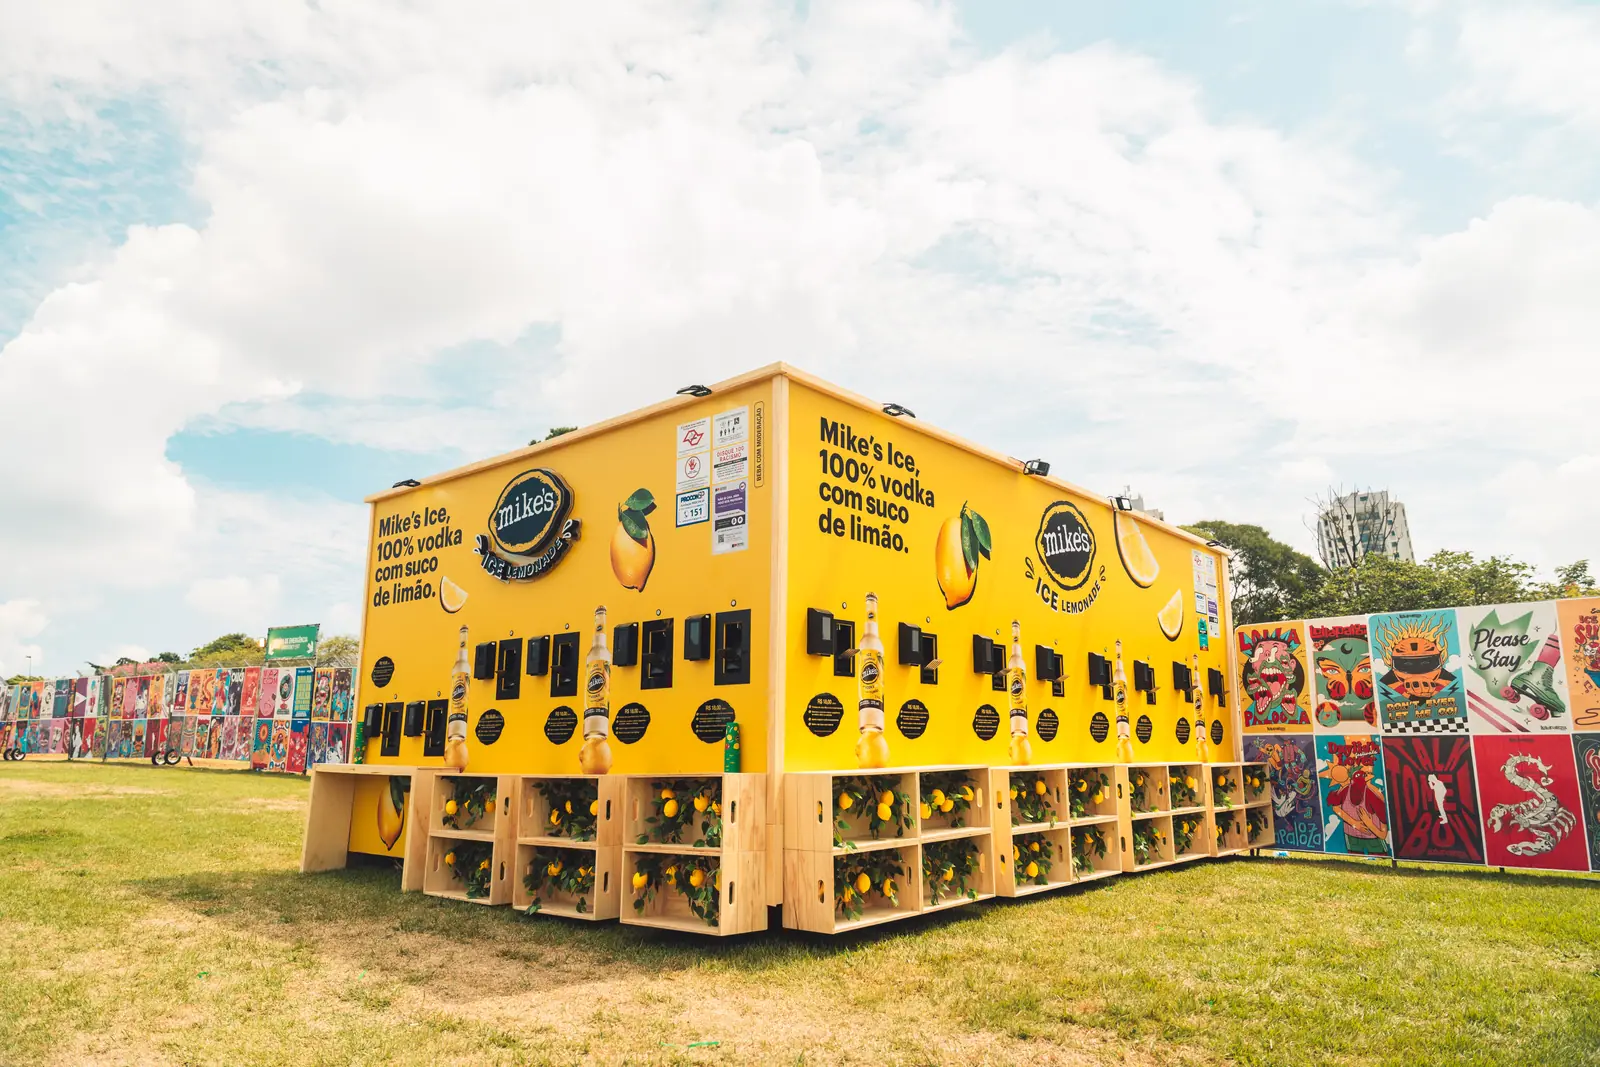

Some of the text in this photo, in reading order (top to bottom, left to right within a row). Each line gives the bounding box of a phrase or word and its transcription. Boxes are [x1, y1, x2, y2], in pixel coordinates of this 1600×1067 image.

[820, 416, 920, 477] Mike's Ice,
[820, 449, 934, 508] 100% vodka
[690, 508, 702, 517] 151
[820, 482, 909, 524] com suco
[379, 507, 451, 537] Mike's Ice,
[819, 508, 909, 553] de limão.
[377, 529, 462, 562] 100% vodka
[481, 537, 563, 579] ICE LEMONADE
[375, 556, 438, 582] com suco
[373, 580, 436, 607] de limão.
[1036, 577, 1100, 613] ICE LEMONADE
[1474, 628, 1530, 651] Please
[1478, 649, 1522, 672] Stay
[1388, 711, 1408, 720] LET
[1416, 709, 1432, 718] ME
[1426, 697, 1456, 708] EVER
[1244, 710, 1311, 727] PAOOA
[1382, 738, 1470, 772] TALK
